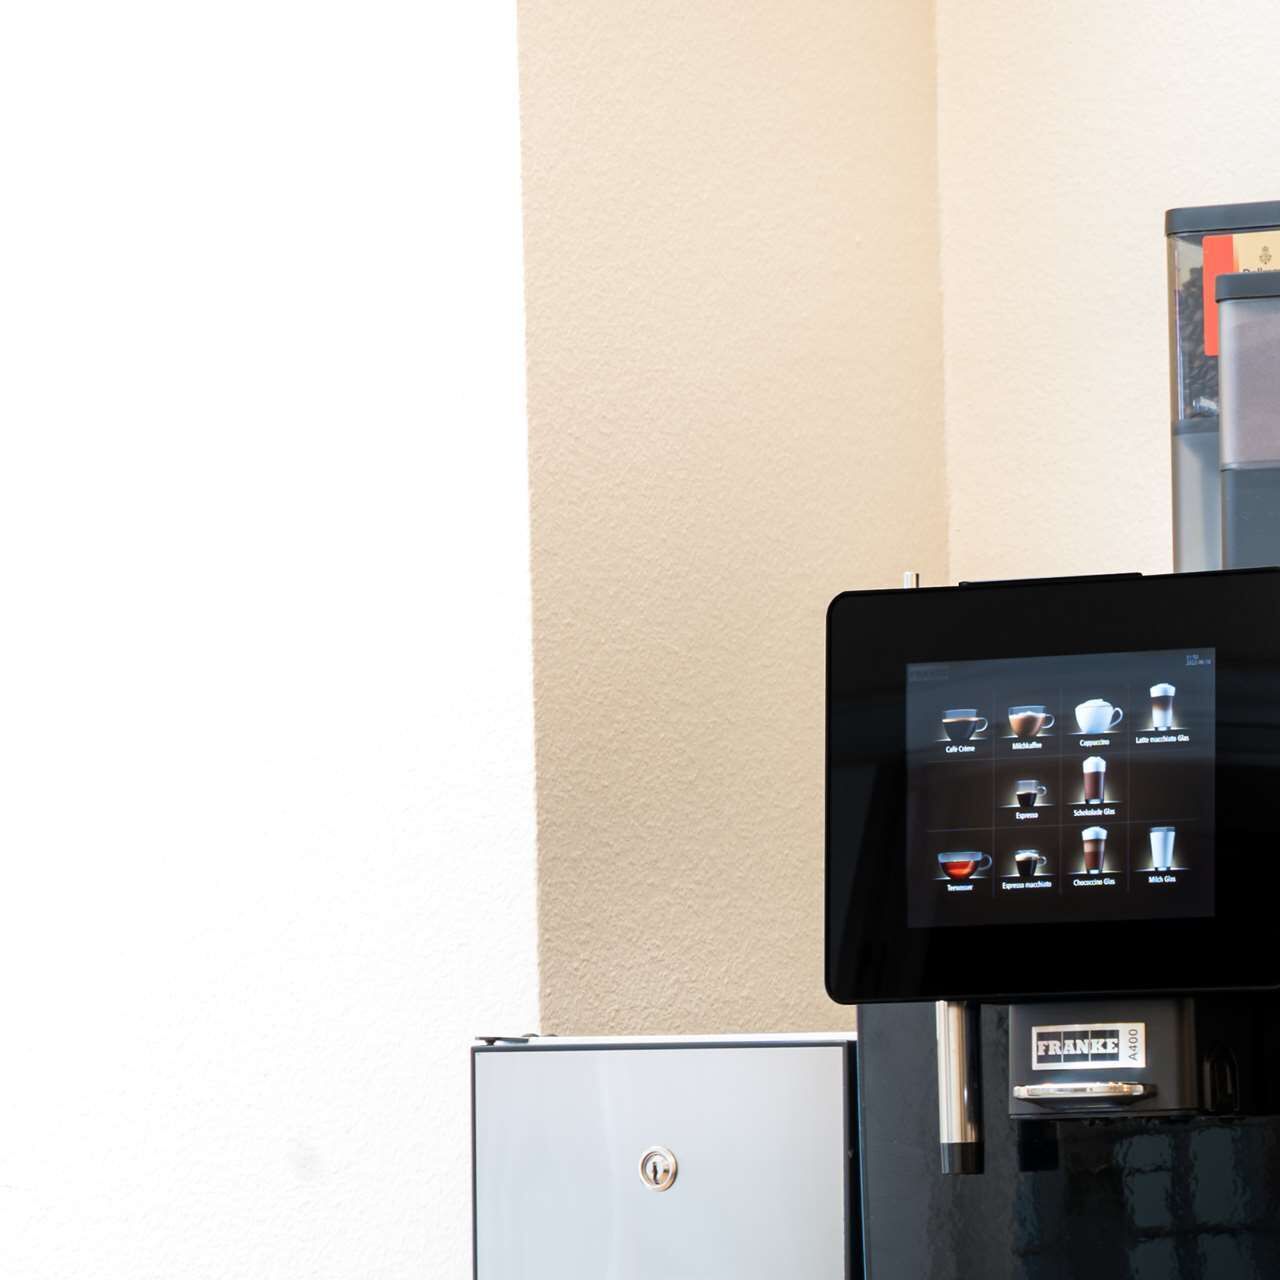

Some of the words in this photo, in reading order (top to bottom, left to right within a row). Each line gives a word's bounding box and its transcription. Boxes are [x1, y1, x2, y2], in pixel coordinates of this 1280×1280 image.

[1178, 734, 1190, 742] Glas
[1080, 739, 1110, 748] Cappuccino
[1016, 812, 1039, 820] Espresso
[1073, 809, 1102, 817] Schokolade
[1164, 875, 1176, 883] Glas
[1002, 882, 1024, 890] Espresso
[1037, 1038, 1119, 1056] FRANKE
[1128, 1028, 1139, 1061] A400
